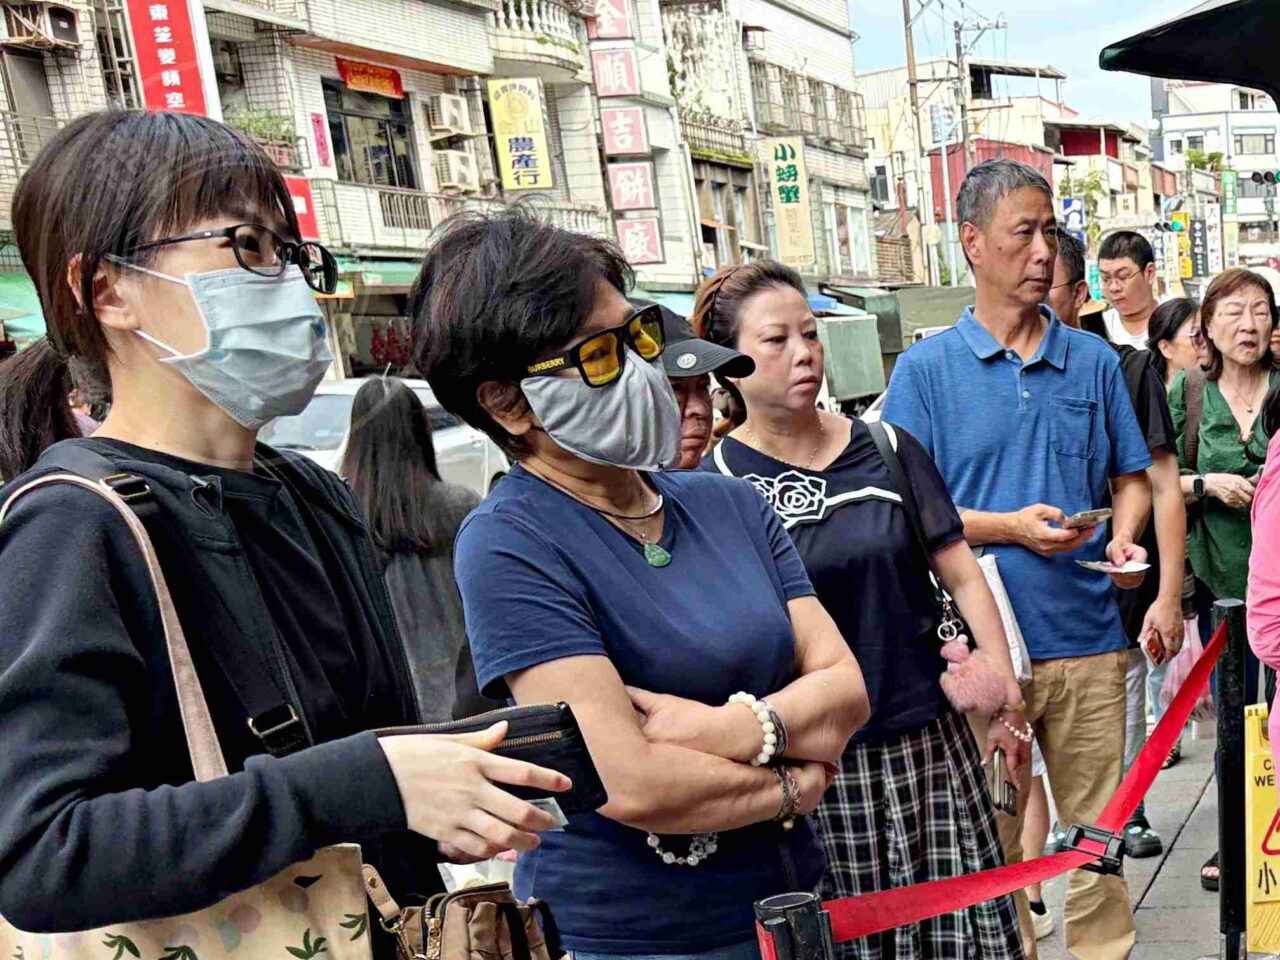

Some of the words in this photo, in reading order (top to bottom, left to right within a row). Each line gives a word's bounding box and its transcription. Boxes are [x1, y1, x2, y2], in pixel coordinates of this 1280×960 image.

[148, 4, 186, 108] 東芝變頻空
[508, 137, 541, 185] 農產行
[1254, 775, 1276, 787] WE
